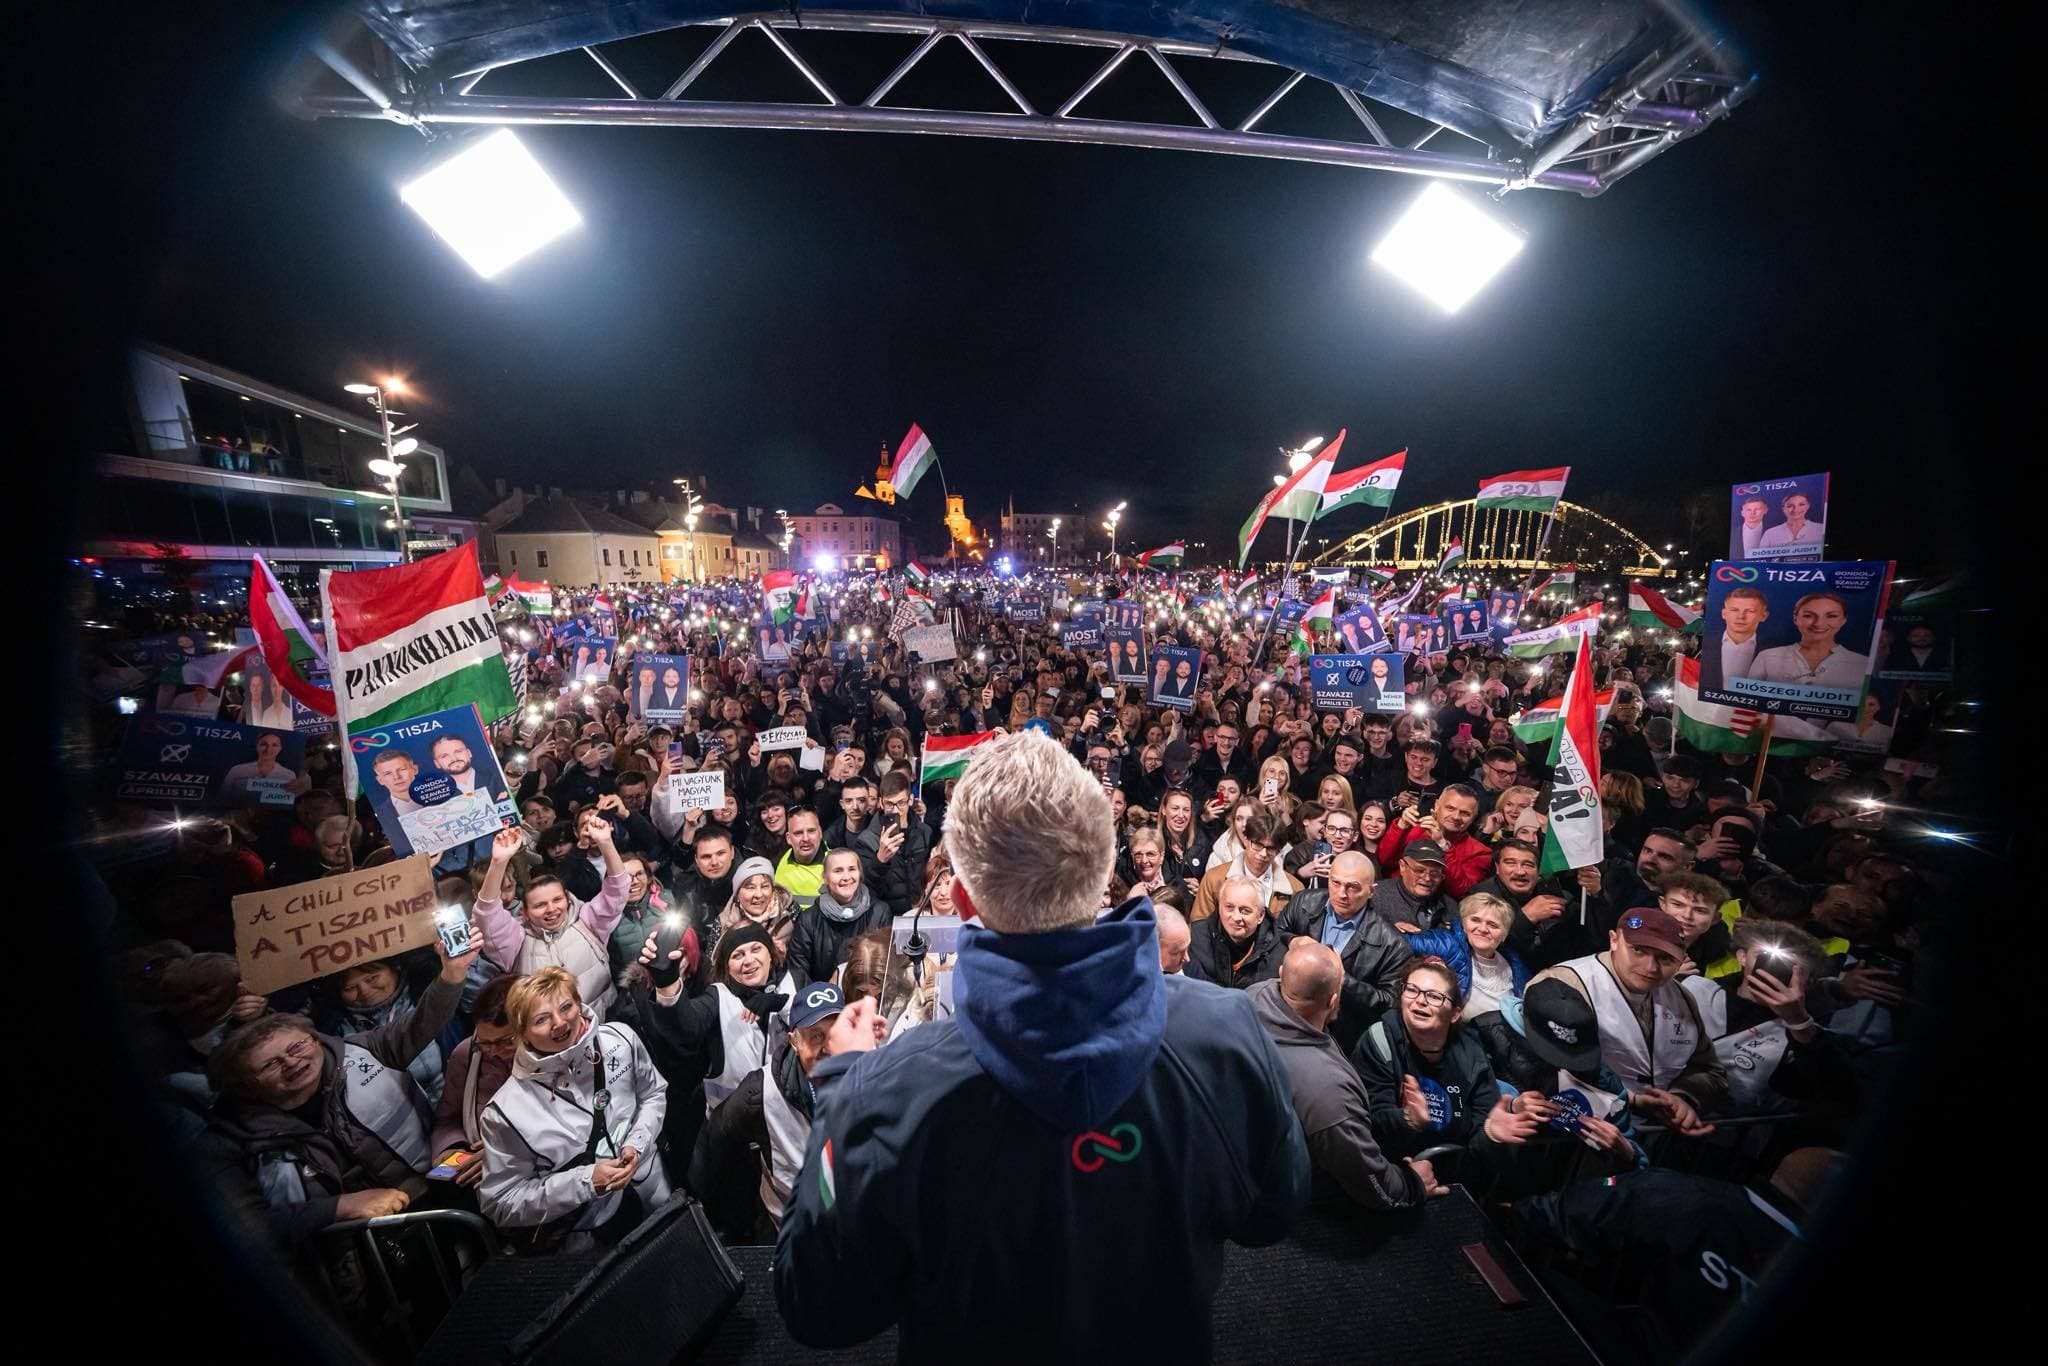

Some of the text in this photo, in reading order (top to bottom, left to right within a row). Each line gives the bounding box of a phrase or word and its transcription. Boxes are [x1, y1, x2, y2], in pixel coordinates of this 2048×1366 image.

[1764, 481, 1797, 491] TISZA
[1767, 568, 1826, 582] TISZA
[1013, 609, 1039, 618] MOST
[1064, 629, 1098, 642] MOST
[345, 612, 497, 700] PANNONHALMA
[1704, 690, 1758, 706] SZAVAZZ!
[1735, 681, 1853, 702] DIÓSZEGI JUDIT
[193, 725, 242, 741] TISZA
[395, 720, 443, 739] TISZA
[122, 770, 211, 786] SZAVAZZ!
[413, 777, 449, 791] GONDOLJ
[672, 775, 722, 787] MI VAGYUNK
[420, 787, 450, 800] SZAVAZZ
[678, 785, 712, 796] MAGYAR
[681, 796, 711, 808] PÉTER
[250, 904, 276, 925] A
[251, 890, 435, 960] A TISZA NYER
[300, 924, 406, 973] PONT!
